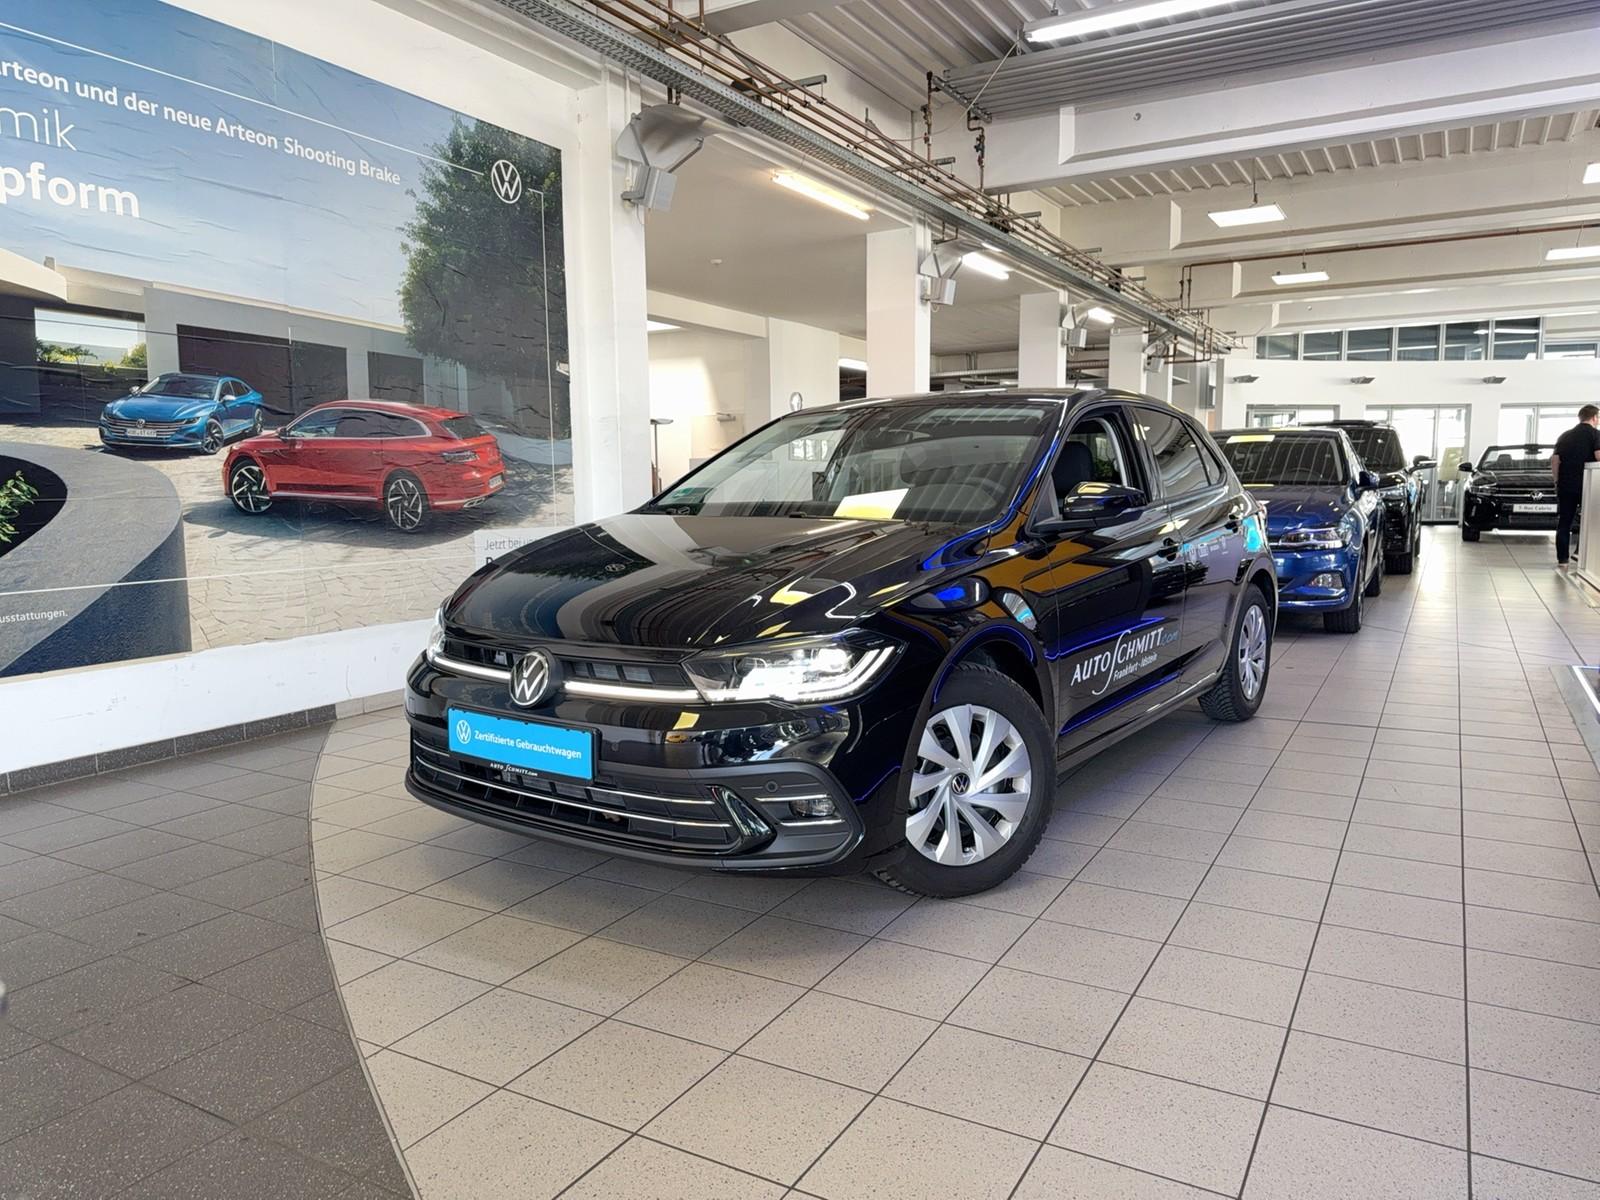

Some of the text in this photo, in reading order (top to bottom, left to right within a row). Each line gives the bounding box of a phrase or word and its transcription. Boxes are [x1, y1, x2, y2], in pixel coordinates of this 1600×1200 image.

[0, 60, 401, 185] rteon und der neue Arteon Shooting Brake
[484, 538, 506, 550] Jetzt
[1113, 662, 1138, 681] Frankfurt
[474, 730, 582, 760] Zertifizierte Gebrauchtwagen
